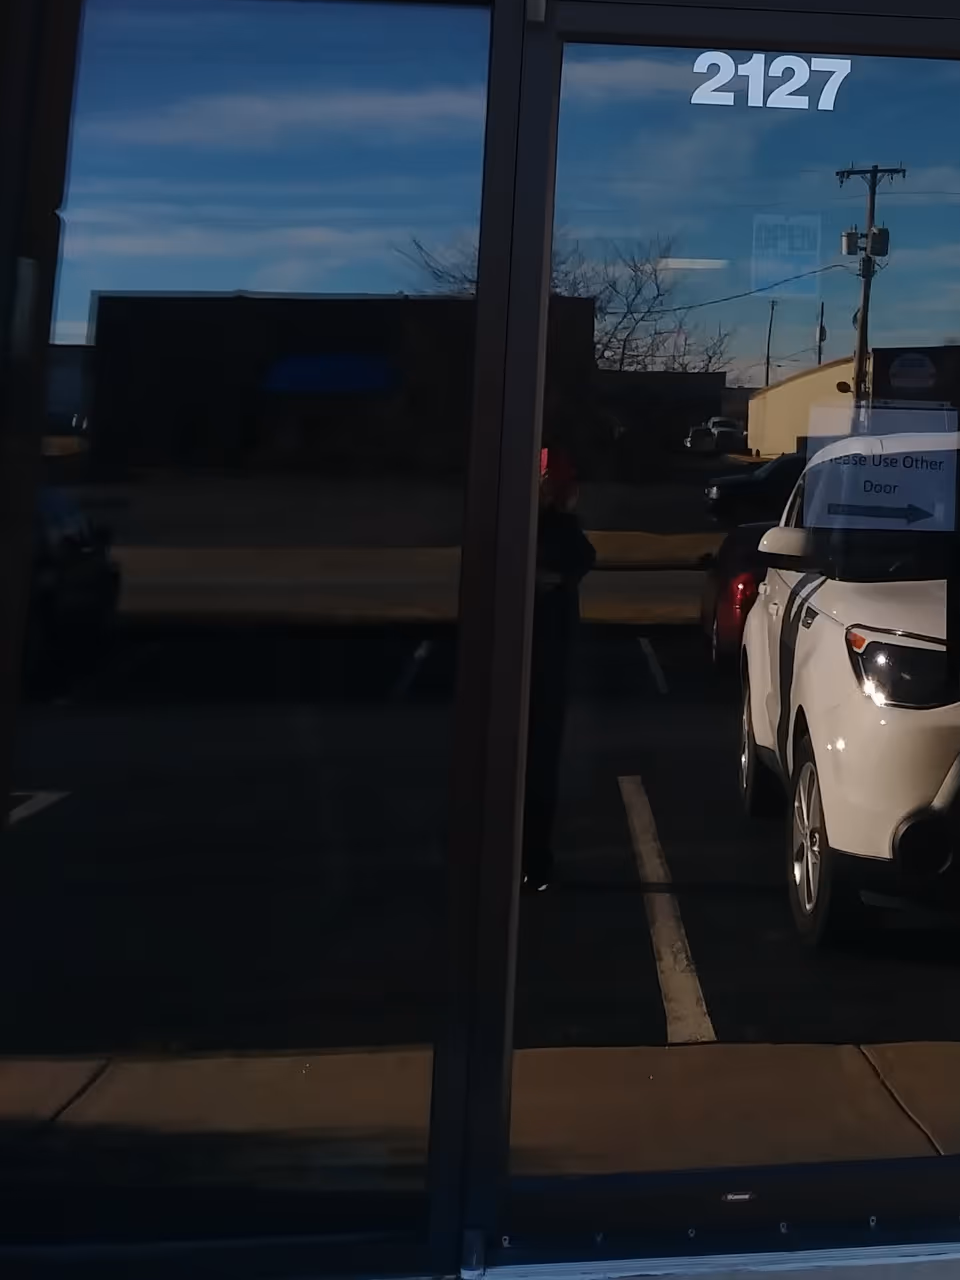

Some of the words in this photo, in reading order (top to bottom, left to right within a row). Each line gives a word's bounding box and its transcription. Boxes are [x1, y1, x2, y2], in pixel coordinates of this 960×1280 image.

[690, 51, 851, 111] 2127
[872, 454, 898, 468] Use
[902, 456, 944, 471] Other
[863, 480, 899, 494] Door
